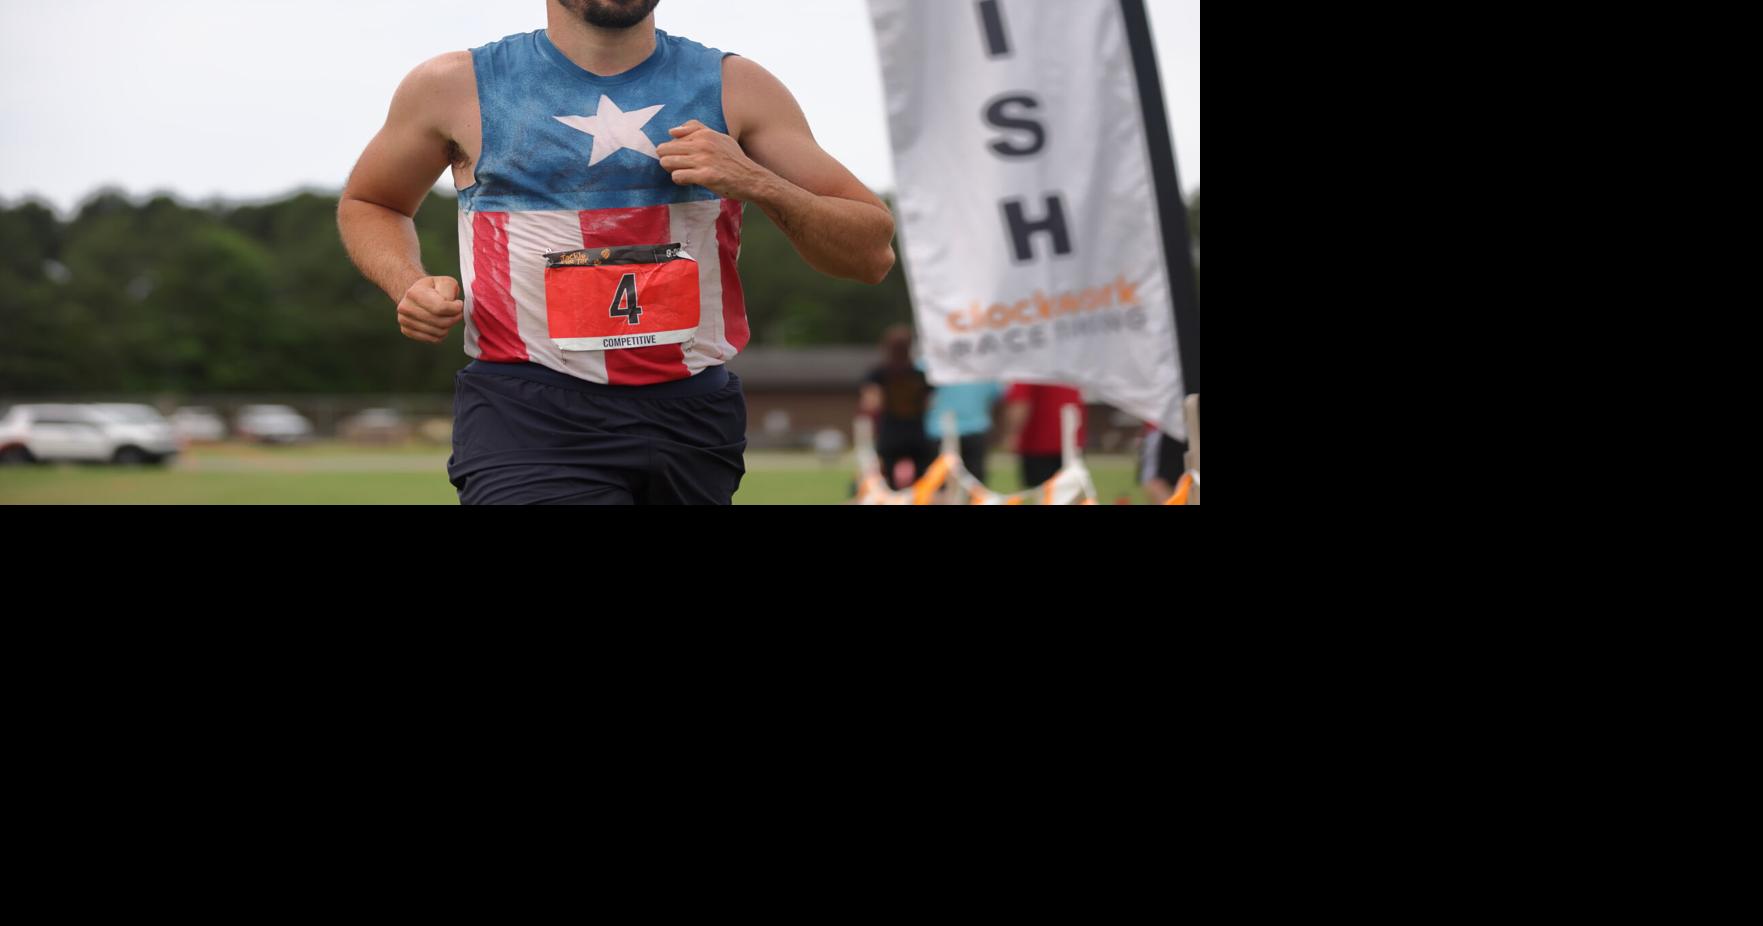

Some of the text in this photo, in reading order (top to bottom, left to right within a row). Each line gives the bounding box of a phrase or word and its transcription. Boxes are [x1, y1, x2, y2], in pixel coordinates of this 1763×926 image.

[609, 272, 643, 326] 4
[946, 275, 1140, 333] clockwork
[603, 335, 656, 348] COMPETITIVE
